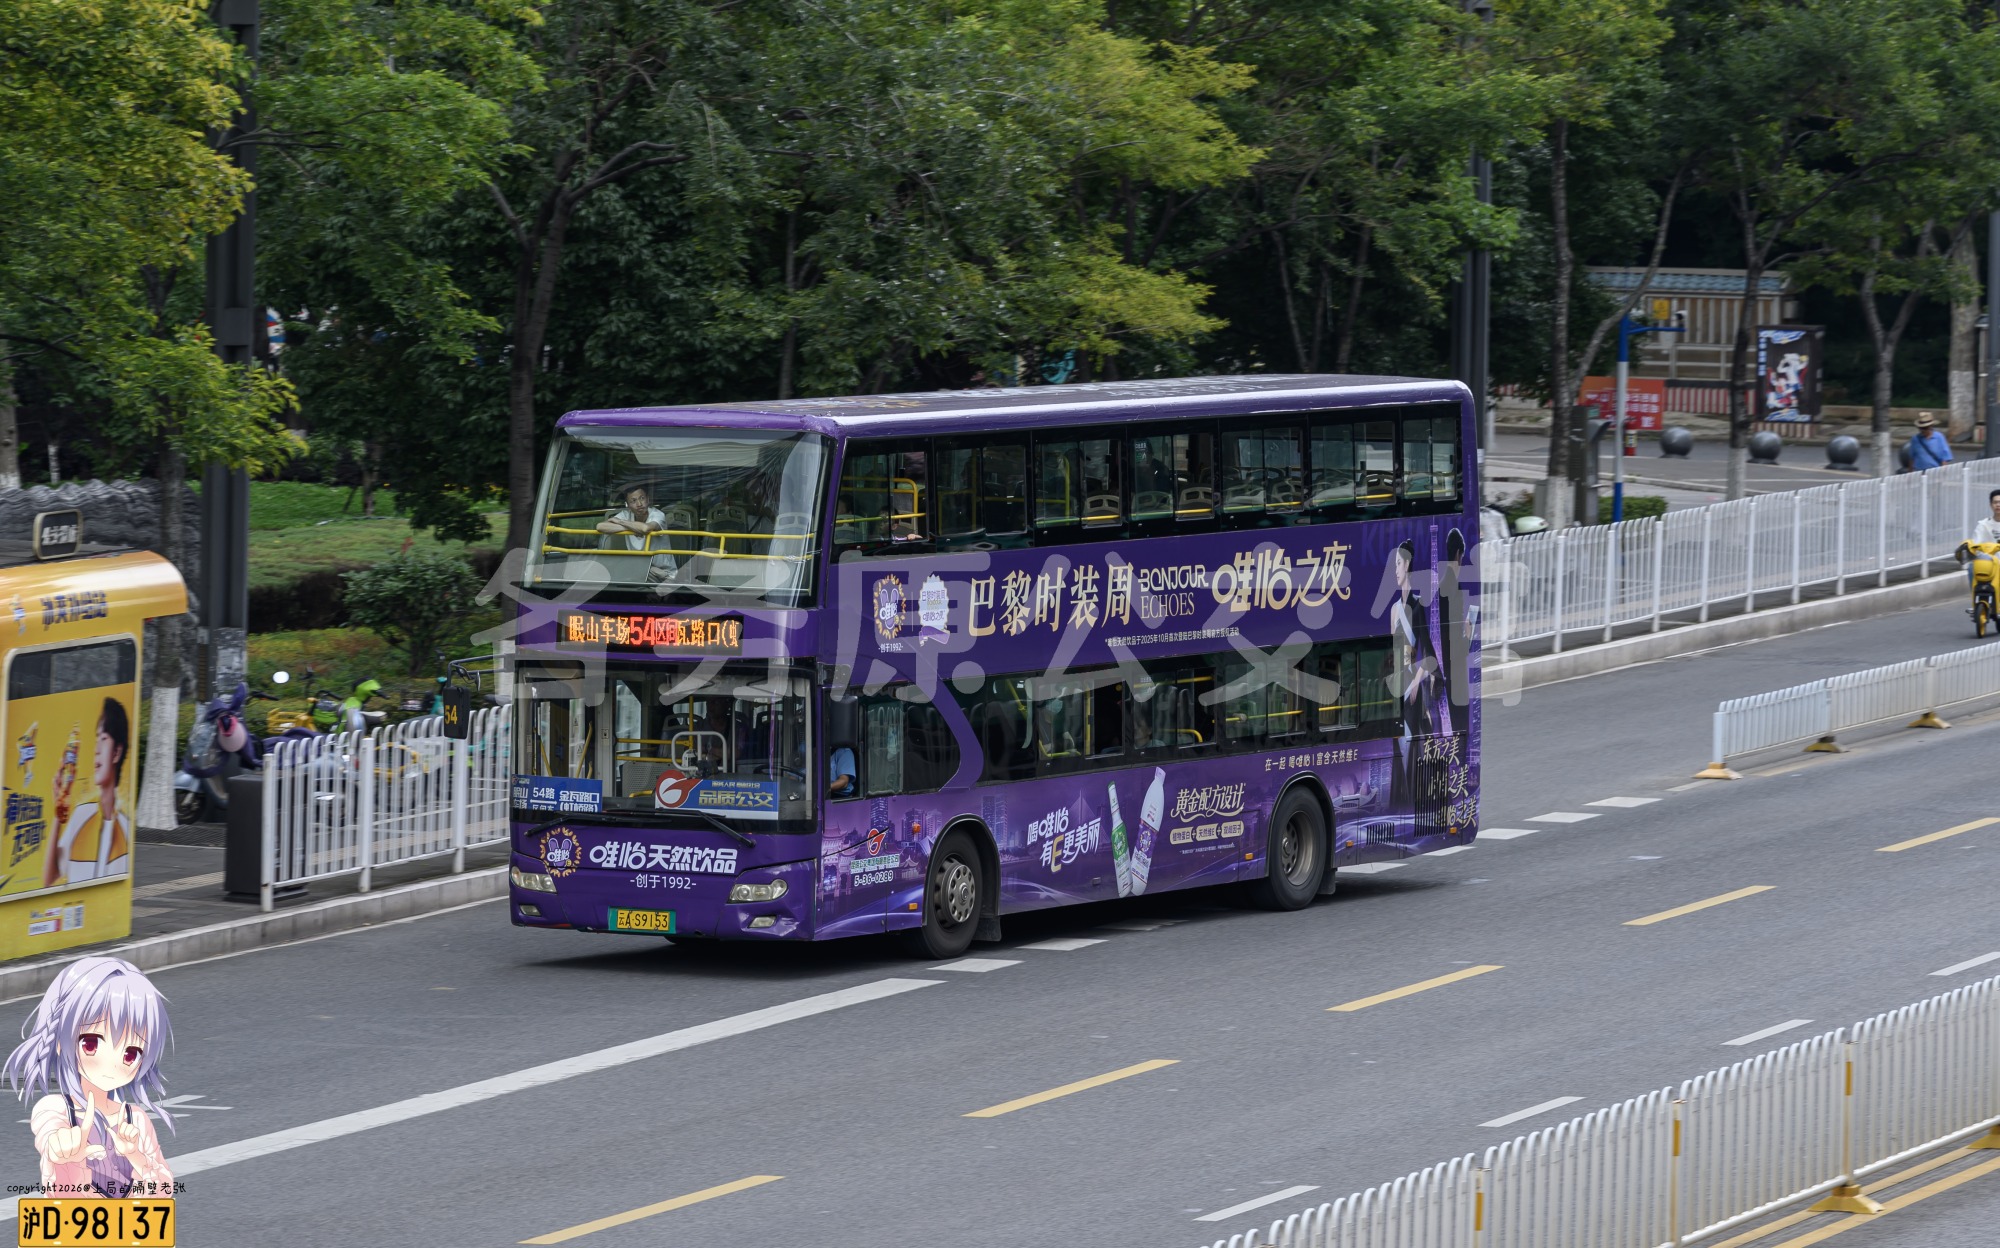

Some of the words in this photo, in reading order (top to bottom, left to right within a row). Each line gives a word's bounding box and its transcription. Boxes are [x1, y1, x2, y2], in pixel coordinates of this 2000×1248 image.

[969, 562, 1134, 637] 巴黎时装周
[1212, 541, 1351, 613] 唯怡之夜
[1138, 564, 1209, 592] BONJOUR
[1141, 592, 1195, 619] ECHOES
[444, 704, 458, 725] 54
[1265, 757, 1286, 771] 在一起
[1316, 749, 1358, 766] 富含天然维E
[1423, 736, 1460, 765] 东方之美
[533, 787, 555, 799] 54路
[559, 790, 600, 803] 金瓦路口
[698, 790, 774, 807] 品质公交
[1170, 783, 1245, 823] 黄金配方设计
[1026, 807, 1069, 846] 喝唯怡
[547, 849, 570, 862] 唯怡
[589, 841, 738, 874] 唯怡天然饮品
[1039, 818, 1101, 875] 有E更美丽
[630, 873, 697, 889] -创于1992-
[618, 911, 668, 928] 云A·S9153
